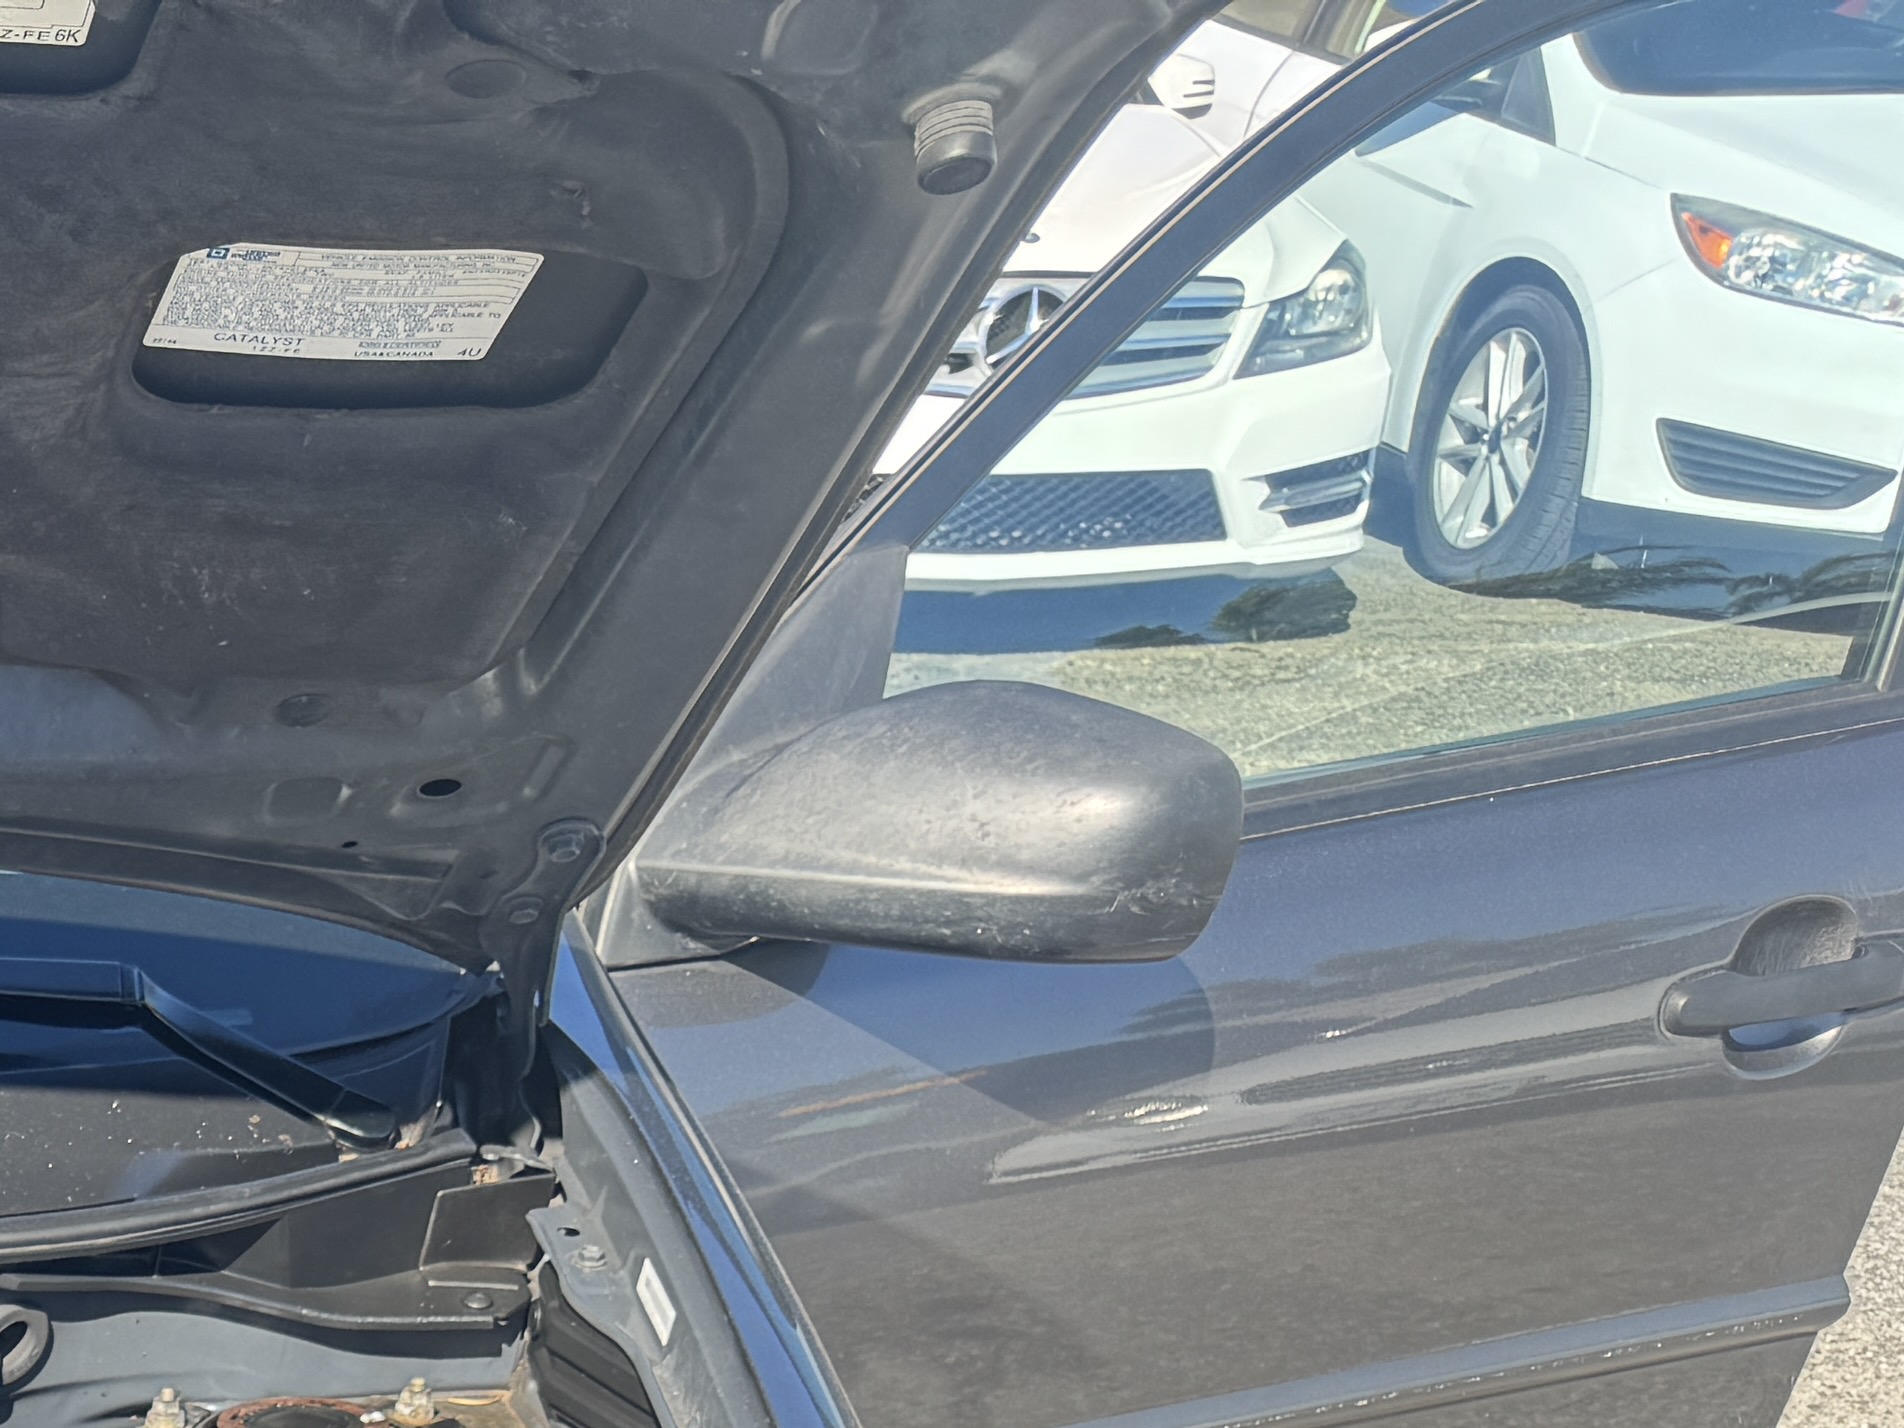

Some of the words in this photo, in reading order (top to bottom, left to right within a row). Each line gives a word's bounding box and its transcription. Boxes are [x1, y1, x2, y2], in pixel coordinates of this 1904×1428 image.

[53, 29, 81, 42] 6K
[213, 332, 306, 345] CATALYST
[456, 347, 482, 357] 4U
